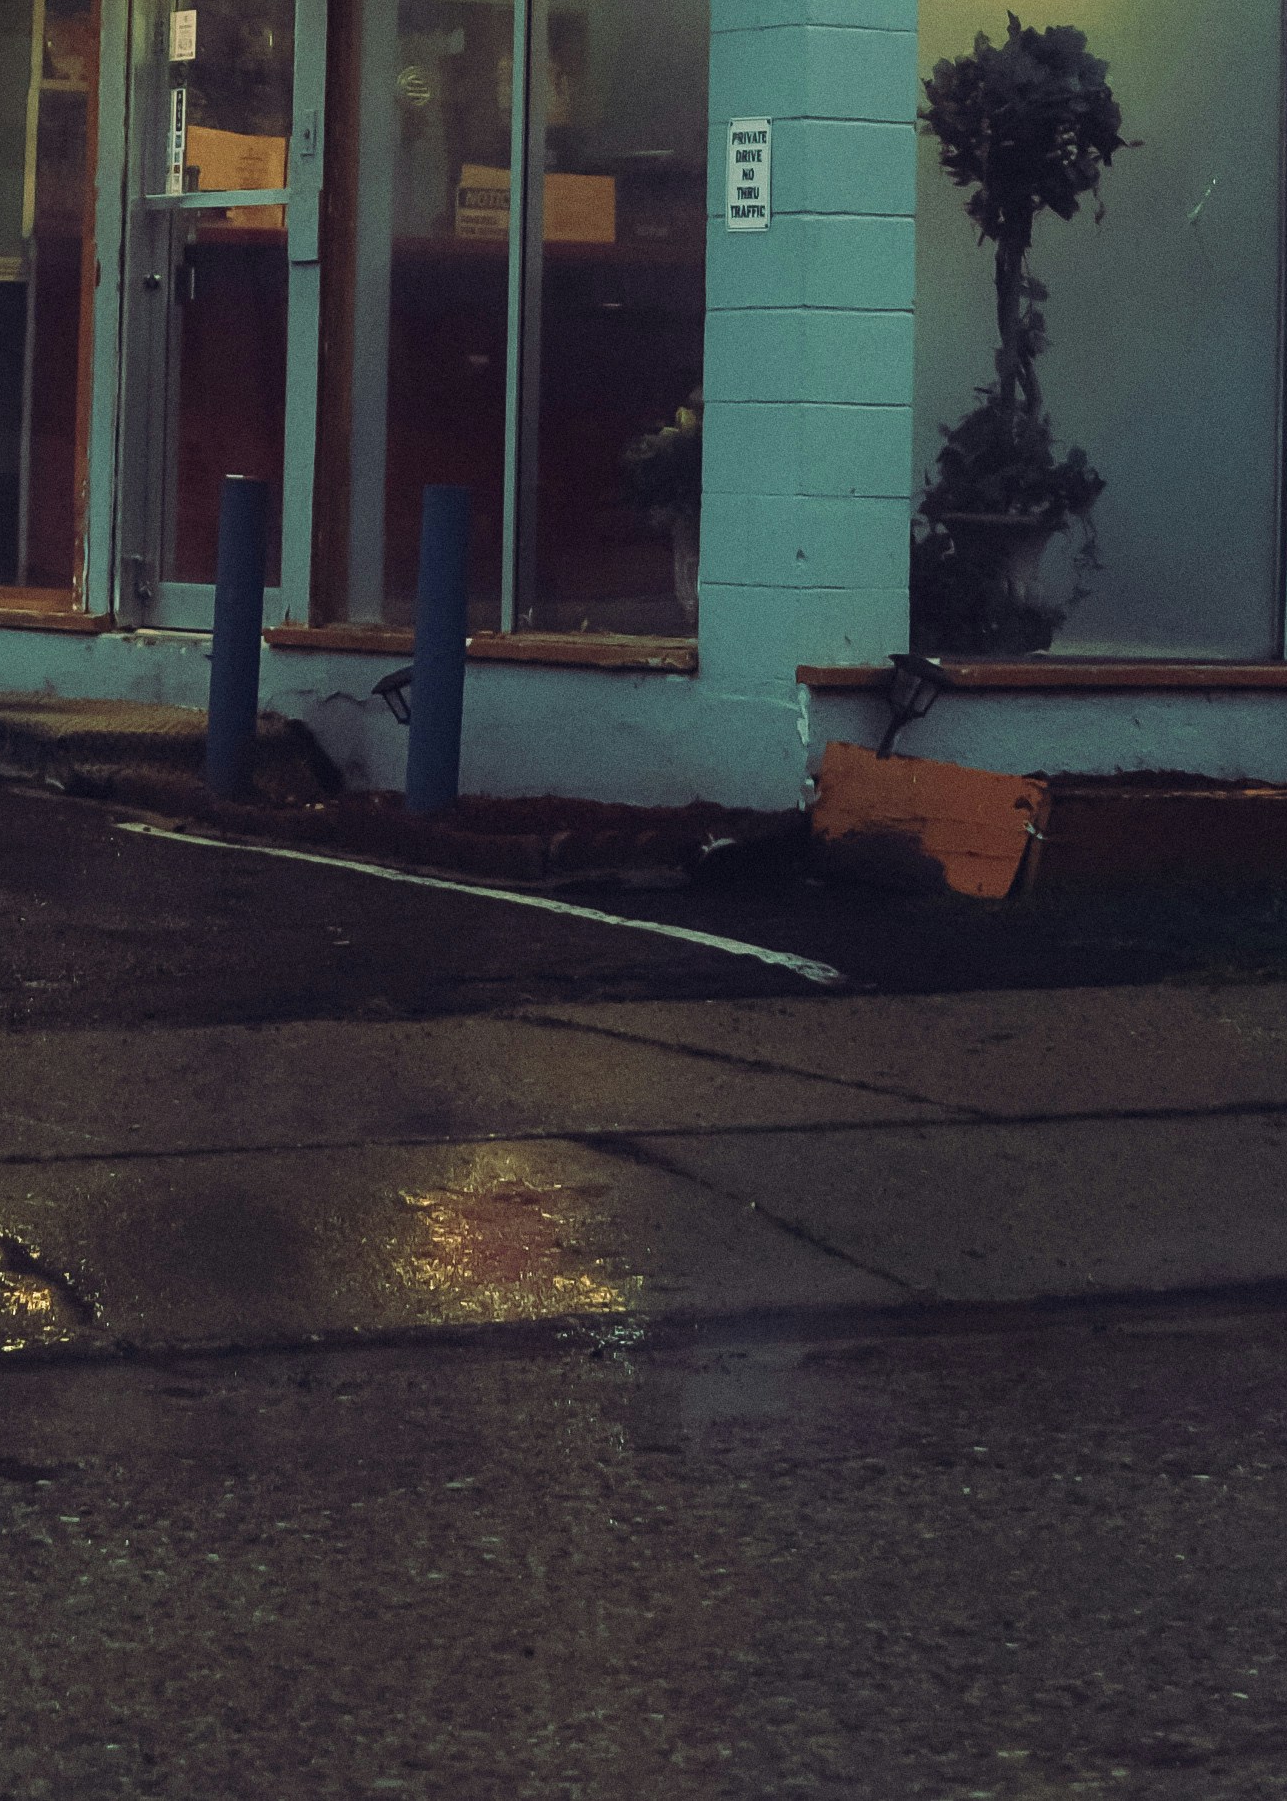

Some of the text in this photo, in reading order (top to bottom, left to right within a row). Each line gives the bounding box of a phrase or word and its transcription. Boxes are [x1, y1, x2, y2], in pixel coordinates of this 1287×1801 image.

[731, 130, 767, 145] PRIVATE
[735, 149, 762, 163] DRIVE
[742, 168, 755, 181] NO
[464, 189, 510, 208] NOTIC
[736, 186, 760, 200] THRU
[730, 204, 766, 218] TRAFFIC
